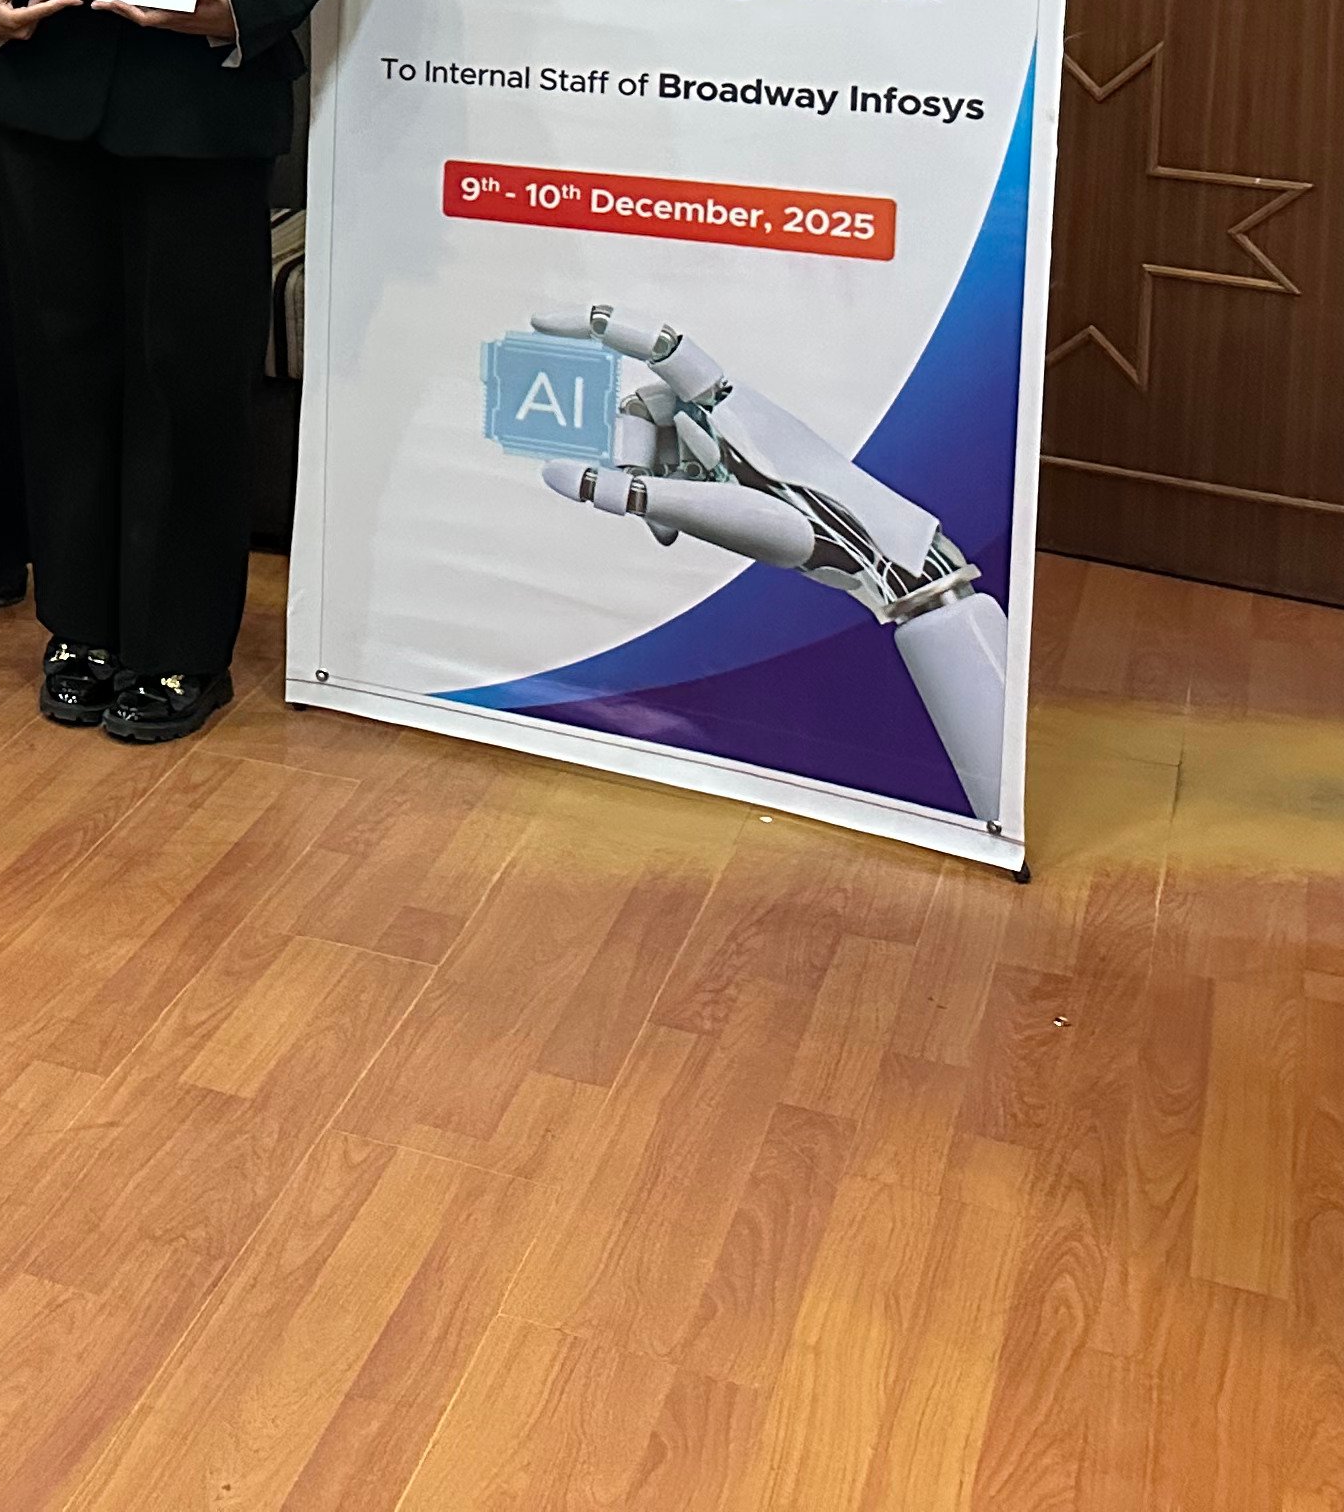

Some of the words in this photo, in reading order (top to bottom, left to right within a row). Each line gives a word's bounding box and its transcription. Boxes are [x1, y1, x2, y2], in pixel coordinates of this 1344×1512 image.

[381, 57, 416, 82] To
[424, 60, 530, 89] Internal
[540, 68, 609, 93] Staff
[618, 72, 649, 96] of
[659, 73, 838, 116] Broadway
[850, 85, 984, 124] Infosys
[461, 176, 500, 201] 9th
[526, 183, 581, 209] 10th
[590, 188, 773, 234] December,
[783, 206, 875, 240] 2025
[515, 371, 583, 428] AI
